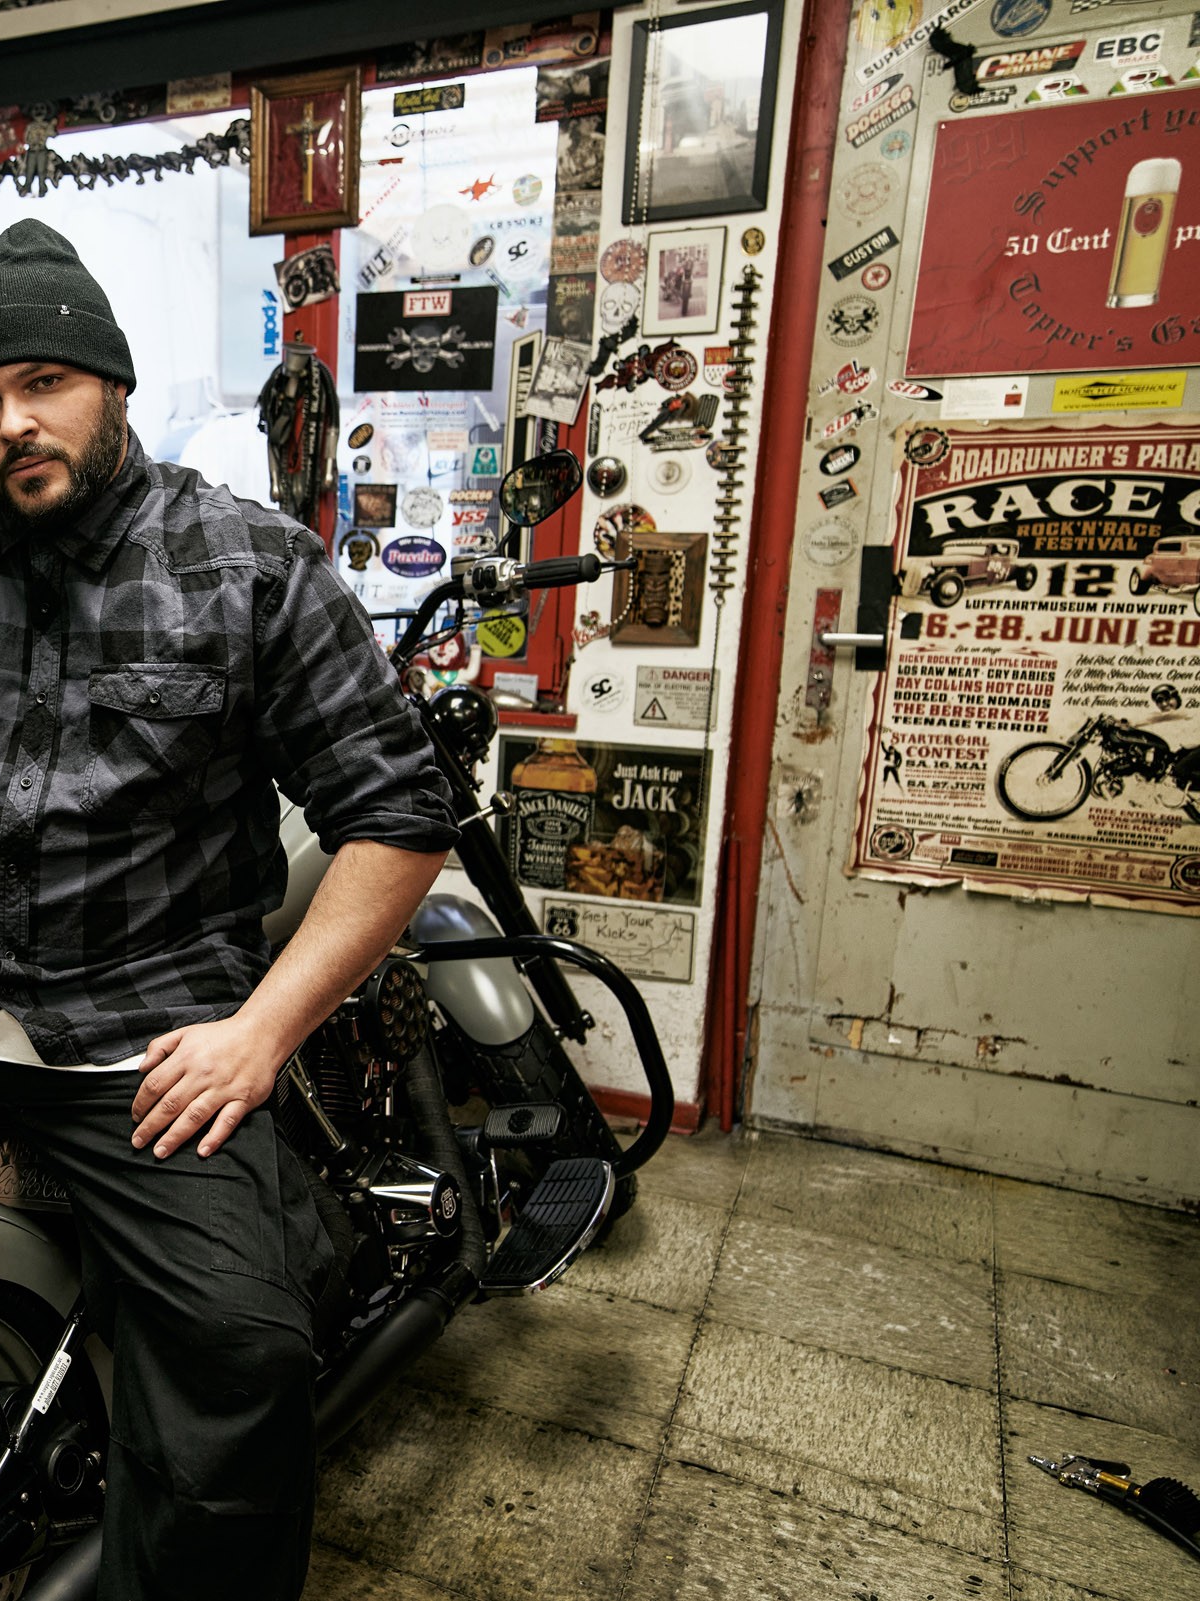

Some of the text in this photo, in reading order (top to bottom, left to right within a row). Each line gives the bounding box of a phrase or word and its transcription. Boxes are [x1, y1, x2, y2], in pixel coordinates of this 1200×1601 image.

[1096, 33, 1161, 60] EBC
[976, 44, 1076, 80] CRANE
[1117, 54, 1158, 64] BRAKES
[847, 86, 913, 141] DOCK66
[1013, 108, 1152, 226] Support
[843, 231, 891, 268] CUSTOM
[1004, 227, 1111, 257] 50 Cent
[408, 295, 447, 311] FTW
[1009, 272, 1134, 352] Topper's
[263, 304, 280, 356] polini
[948, 446, 1129, 484] ROADRUNNER'S
[452, 509, 488, 526] YSS
[921, 479, 1166, 539] RACE
[1016, 520, 1161, 537] ROCK'N'RACE
[1035, 536, 1138, 551] FESTIVAL
[1044, 562, 1116, 598] 12
[965, 598, 1188, 615] LUFTFAHRTMUSEUM FINOWFURT
[926, 613, 1033, 642] 6.-28.
[1040, 616, 1140, 645] JUNI
[899, 654, 925, 664] RICKY
[927, 655, 961, 665] ROCKET
[972, 657, 986, 666] HIS
[989, 658, 1018, 668] LITTLE
[1020, 660, 1058, 670] GREENS
[1076, 654, 1093, 666] Hot
[1118, 655, 1154, 666] Classic
[1155, 655, 1176, 666] Car
[662, 670, 711, 681] DANGER
[898, 665, 1056, 682] LOS RAW MEAT CRY BABIES
[1107, 669, 1133, 679] Show
[1166, 668, 1193, 681] Open
[664, 683, 692, 691] ELECTRIC
[896, 677, 1054, 697] RAY COLLINS HOT CLUB
[1062, 681, 1080, 692] Hot
[1115, 682, 1150, 693] Parties
[894, 691, 1051, 708] BOOZED THE NOMADS
[893, 702, 1049, 723] THE BERSERKERZ
[892, 715, 1048, 734] TEENAGE TERROR
[890, 732, 953, 746] STARTER
[906, 746, 989, 760] CONTEST
[613, 763, 683, 783] Just Ask For
[954, 761, 988, 770] MAI
[951, 781, 985, 791] JUNI
[612, 779, 677, 812] JACK
[518, 795, 590, 822] JACK DANIEL'S
[1088, 807, 1183, 822] FREE ENTRY FOR
[1110, 822, 1131, 830] THE
[553, 923, 571, 936] 66
